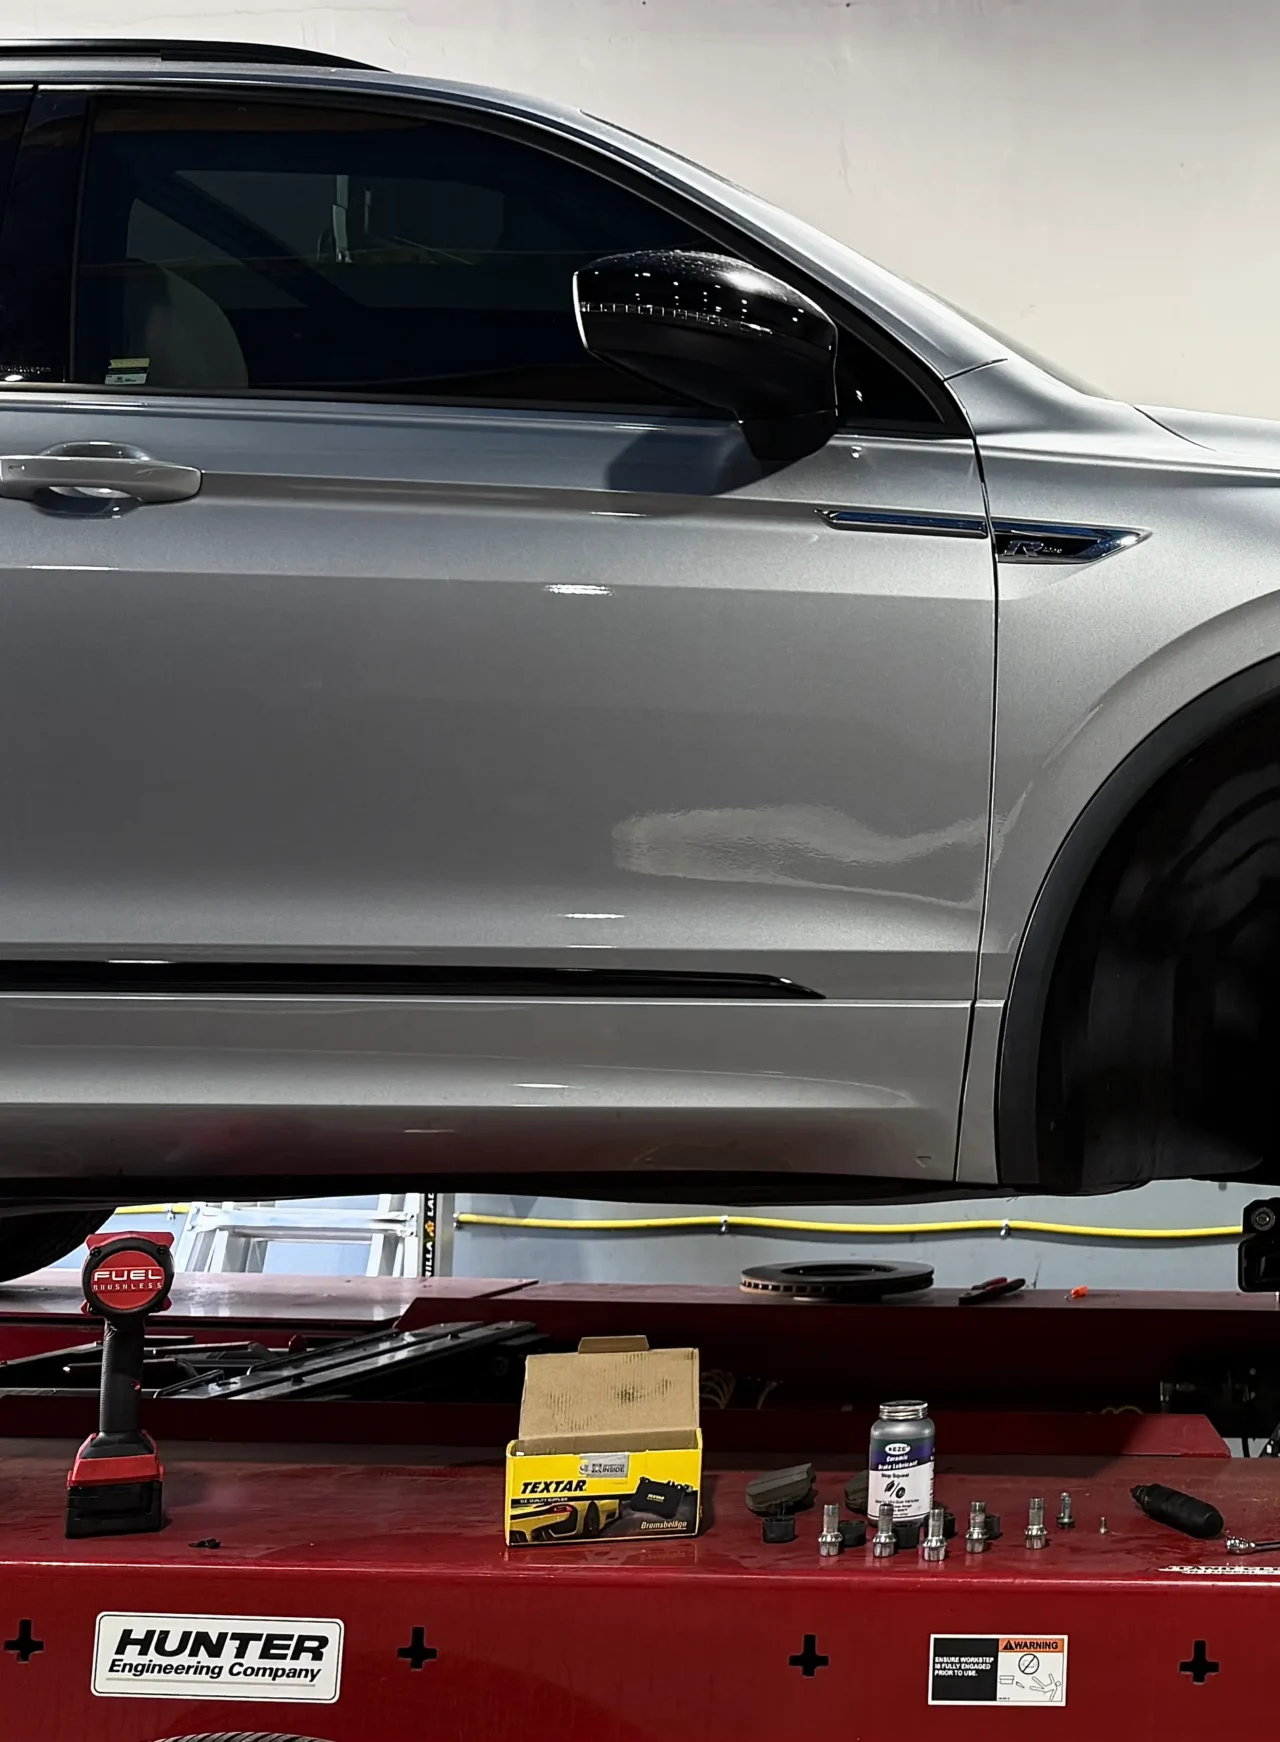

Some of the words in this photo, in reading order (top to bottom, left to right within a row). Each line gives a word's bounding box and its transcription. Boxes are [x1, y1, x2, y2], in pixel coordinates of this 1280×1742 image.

[94, 1270, 162, 1281] FUEL
[93, 1282, 162, 1291] BRUSHLESS
[520, 1480, 587, 1494] TEXTAR
[114, 1629, 330, 1662] HUNTER
[1014, 1641, 1059, 1650] WARNING
[108, 1659, 223, 1679] Engineering
[228, 1662, 322, 1682] Company
